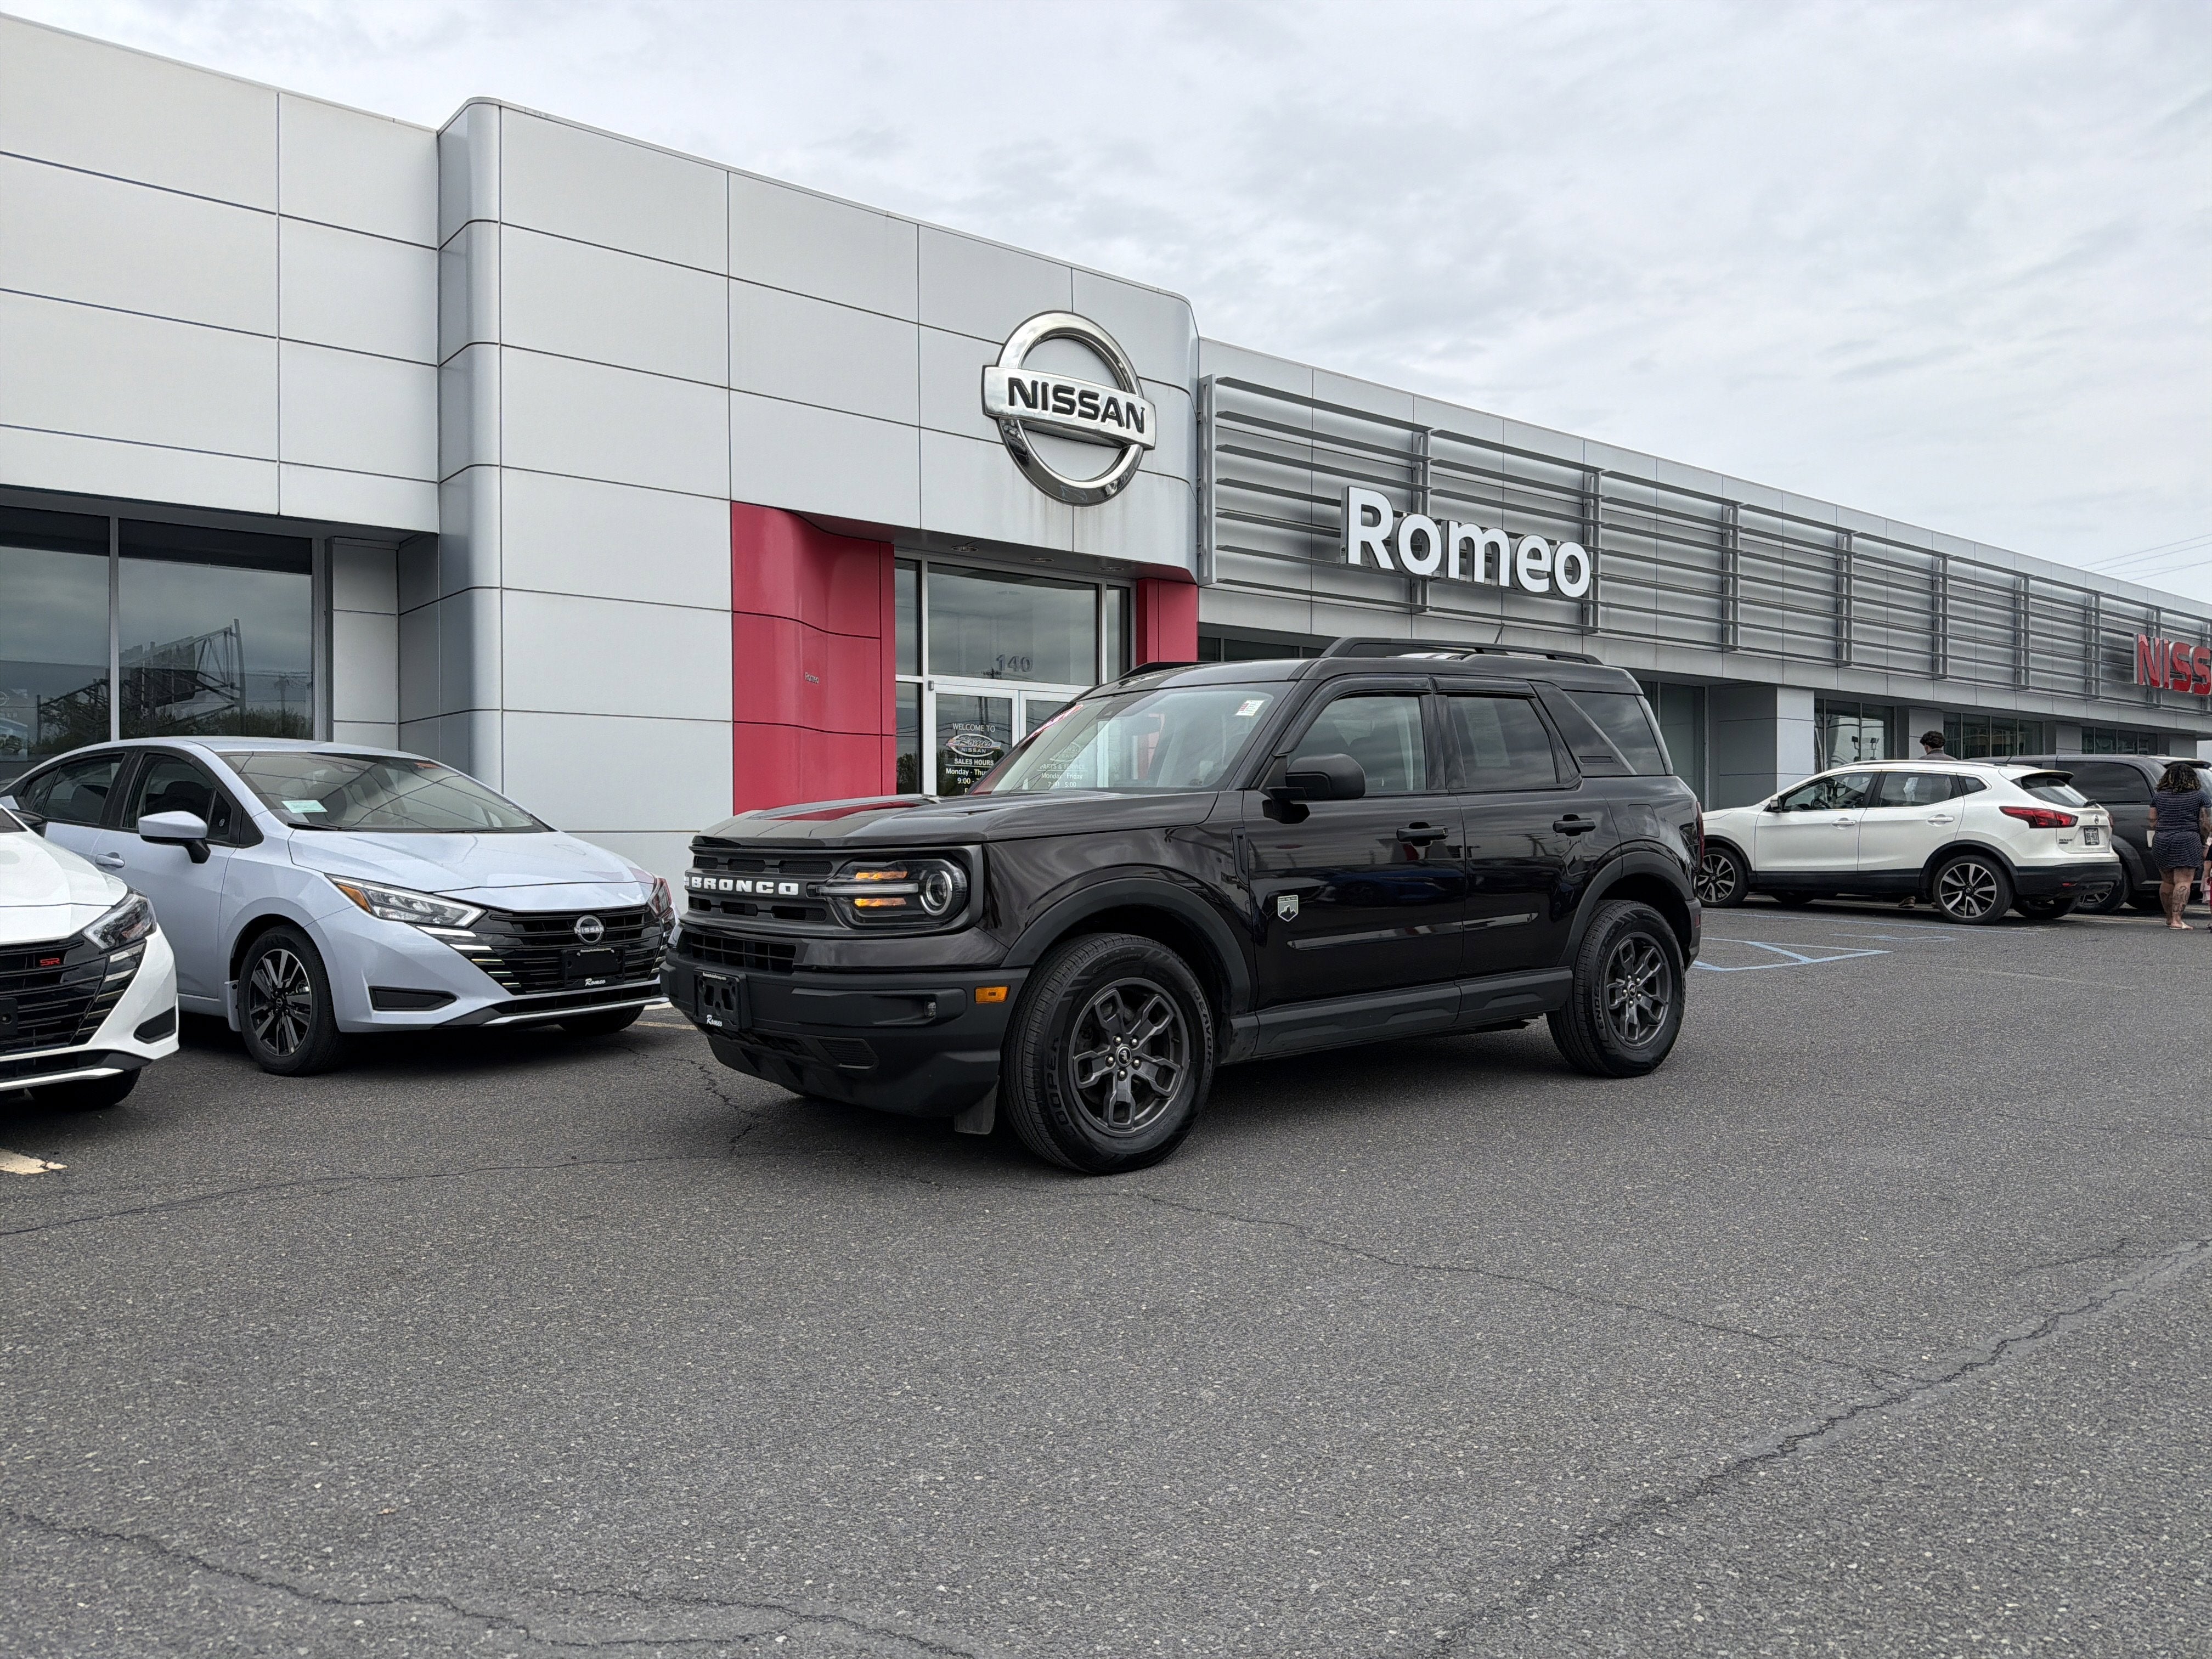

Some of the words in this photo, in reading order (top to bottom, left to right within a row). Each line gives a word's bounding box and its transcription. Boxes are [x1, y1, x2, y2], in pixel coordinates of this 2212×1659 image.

[1008, 376, 1146, 435] NISSAN
[1341, 485, 1591, 597] Romeo
[996, 653, 1034, 673] 140
[2134, 633, 2212, 696] NISS
[805, 672, 819, 684] Romeo
[952, 723, 985, 732] WELCOME
[958, 735, 992, 747] Romeo
[945, 768, 969, 776] Monday
[691, 877, 799, 895] BRONCO
[574, 926, 604, 934] NISSAN
[585, 978, 606, 986] Romeo
[706, 1014, 723, 1027] Romeo
